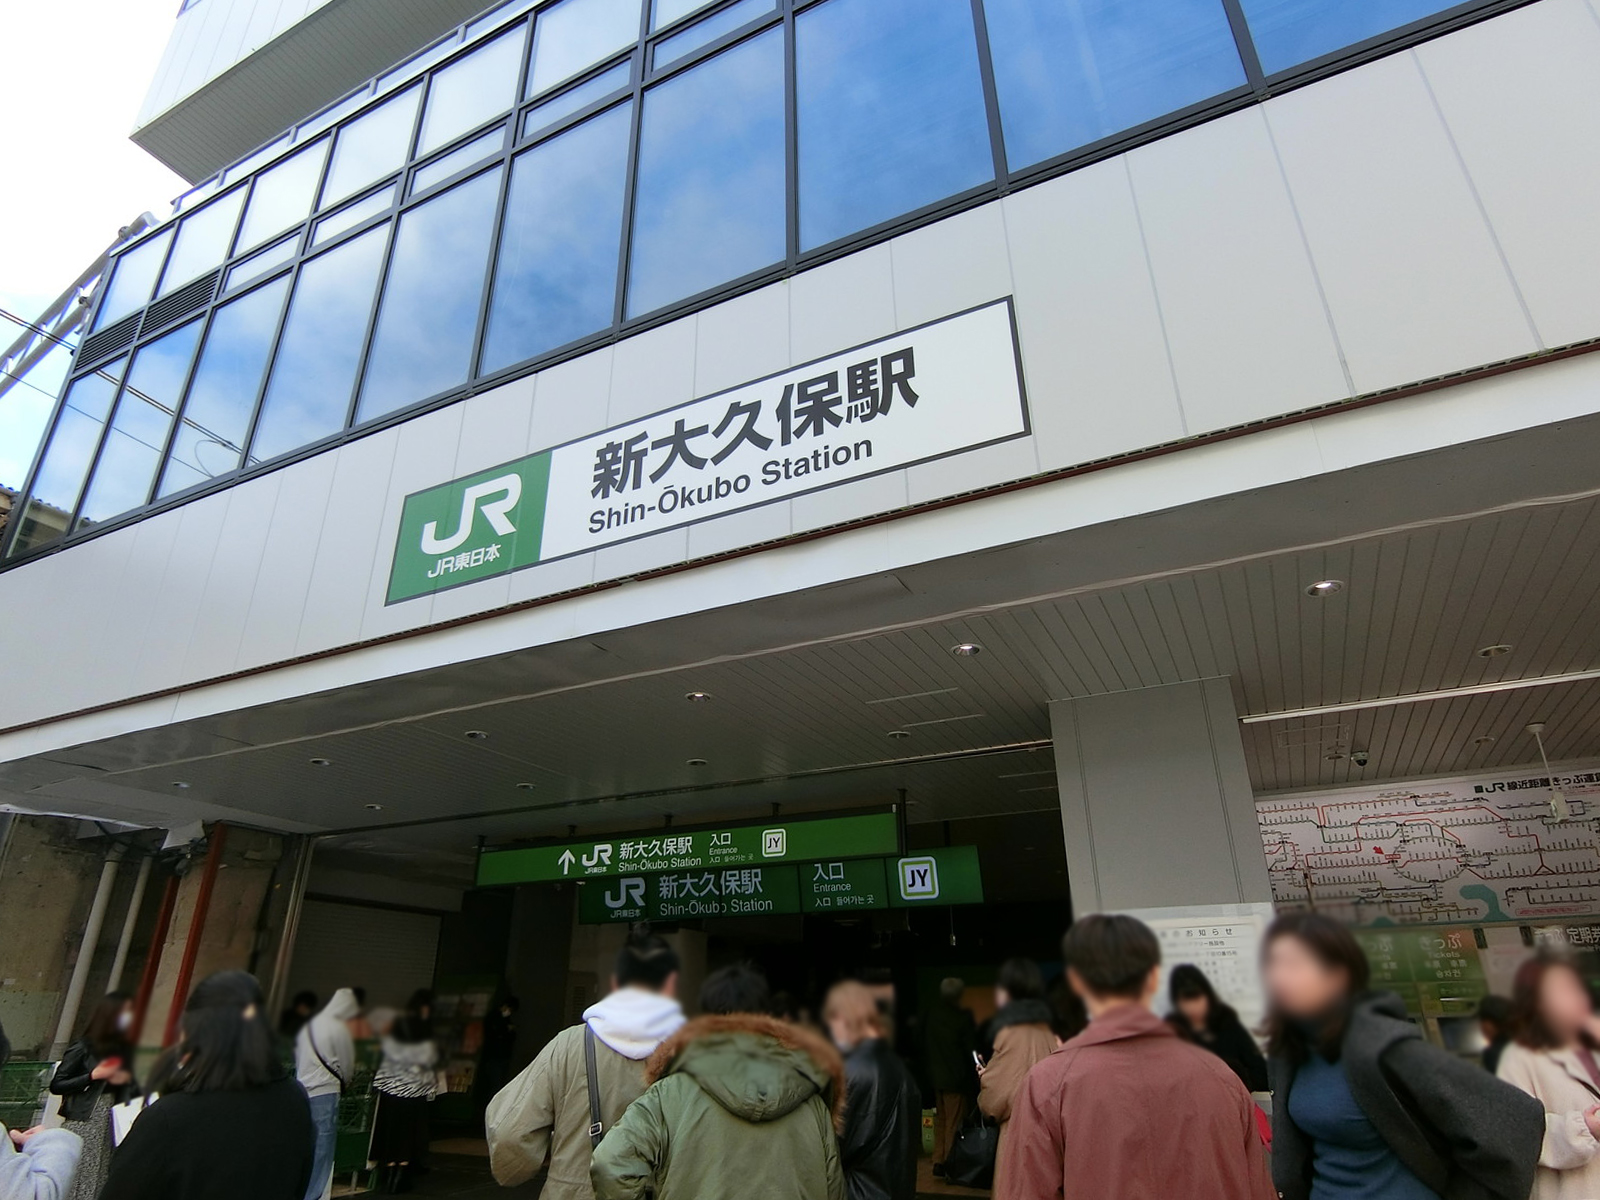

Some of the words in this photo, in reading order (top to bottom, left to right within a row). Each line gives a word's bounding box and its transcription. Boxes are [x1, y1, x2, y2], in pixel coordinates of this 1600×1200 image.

[590, 346, 920, 499] 新大久保駅
[588, 474, 751, 534] Shin-Ōkubo
[761, 438, 873, 485] Station
[420, 473, 522, 555] JR
[427, 543, 502, 578] JR東日本
[618, 835, 693, 860] 新大久保駅
[709, 832, 731, 847] 入口
[767, 837, 781, 849] JY
[581, 843, 612, 867] JR
[709, 847, 738, 856] Entrance
[670, 856, 702, 868] Station
[812, 862, 844, 881] 入口
[658, 868, 763, 900] 新大久保駅
[813, 883, 852, 893] Entrance
[908, 869, 928, 888] JY
[604, 876, 646, 909] JR
[815, 897, 832, 907] 入口
[731, 898, 773, 912] Station
